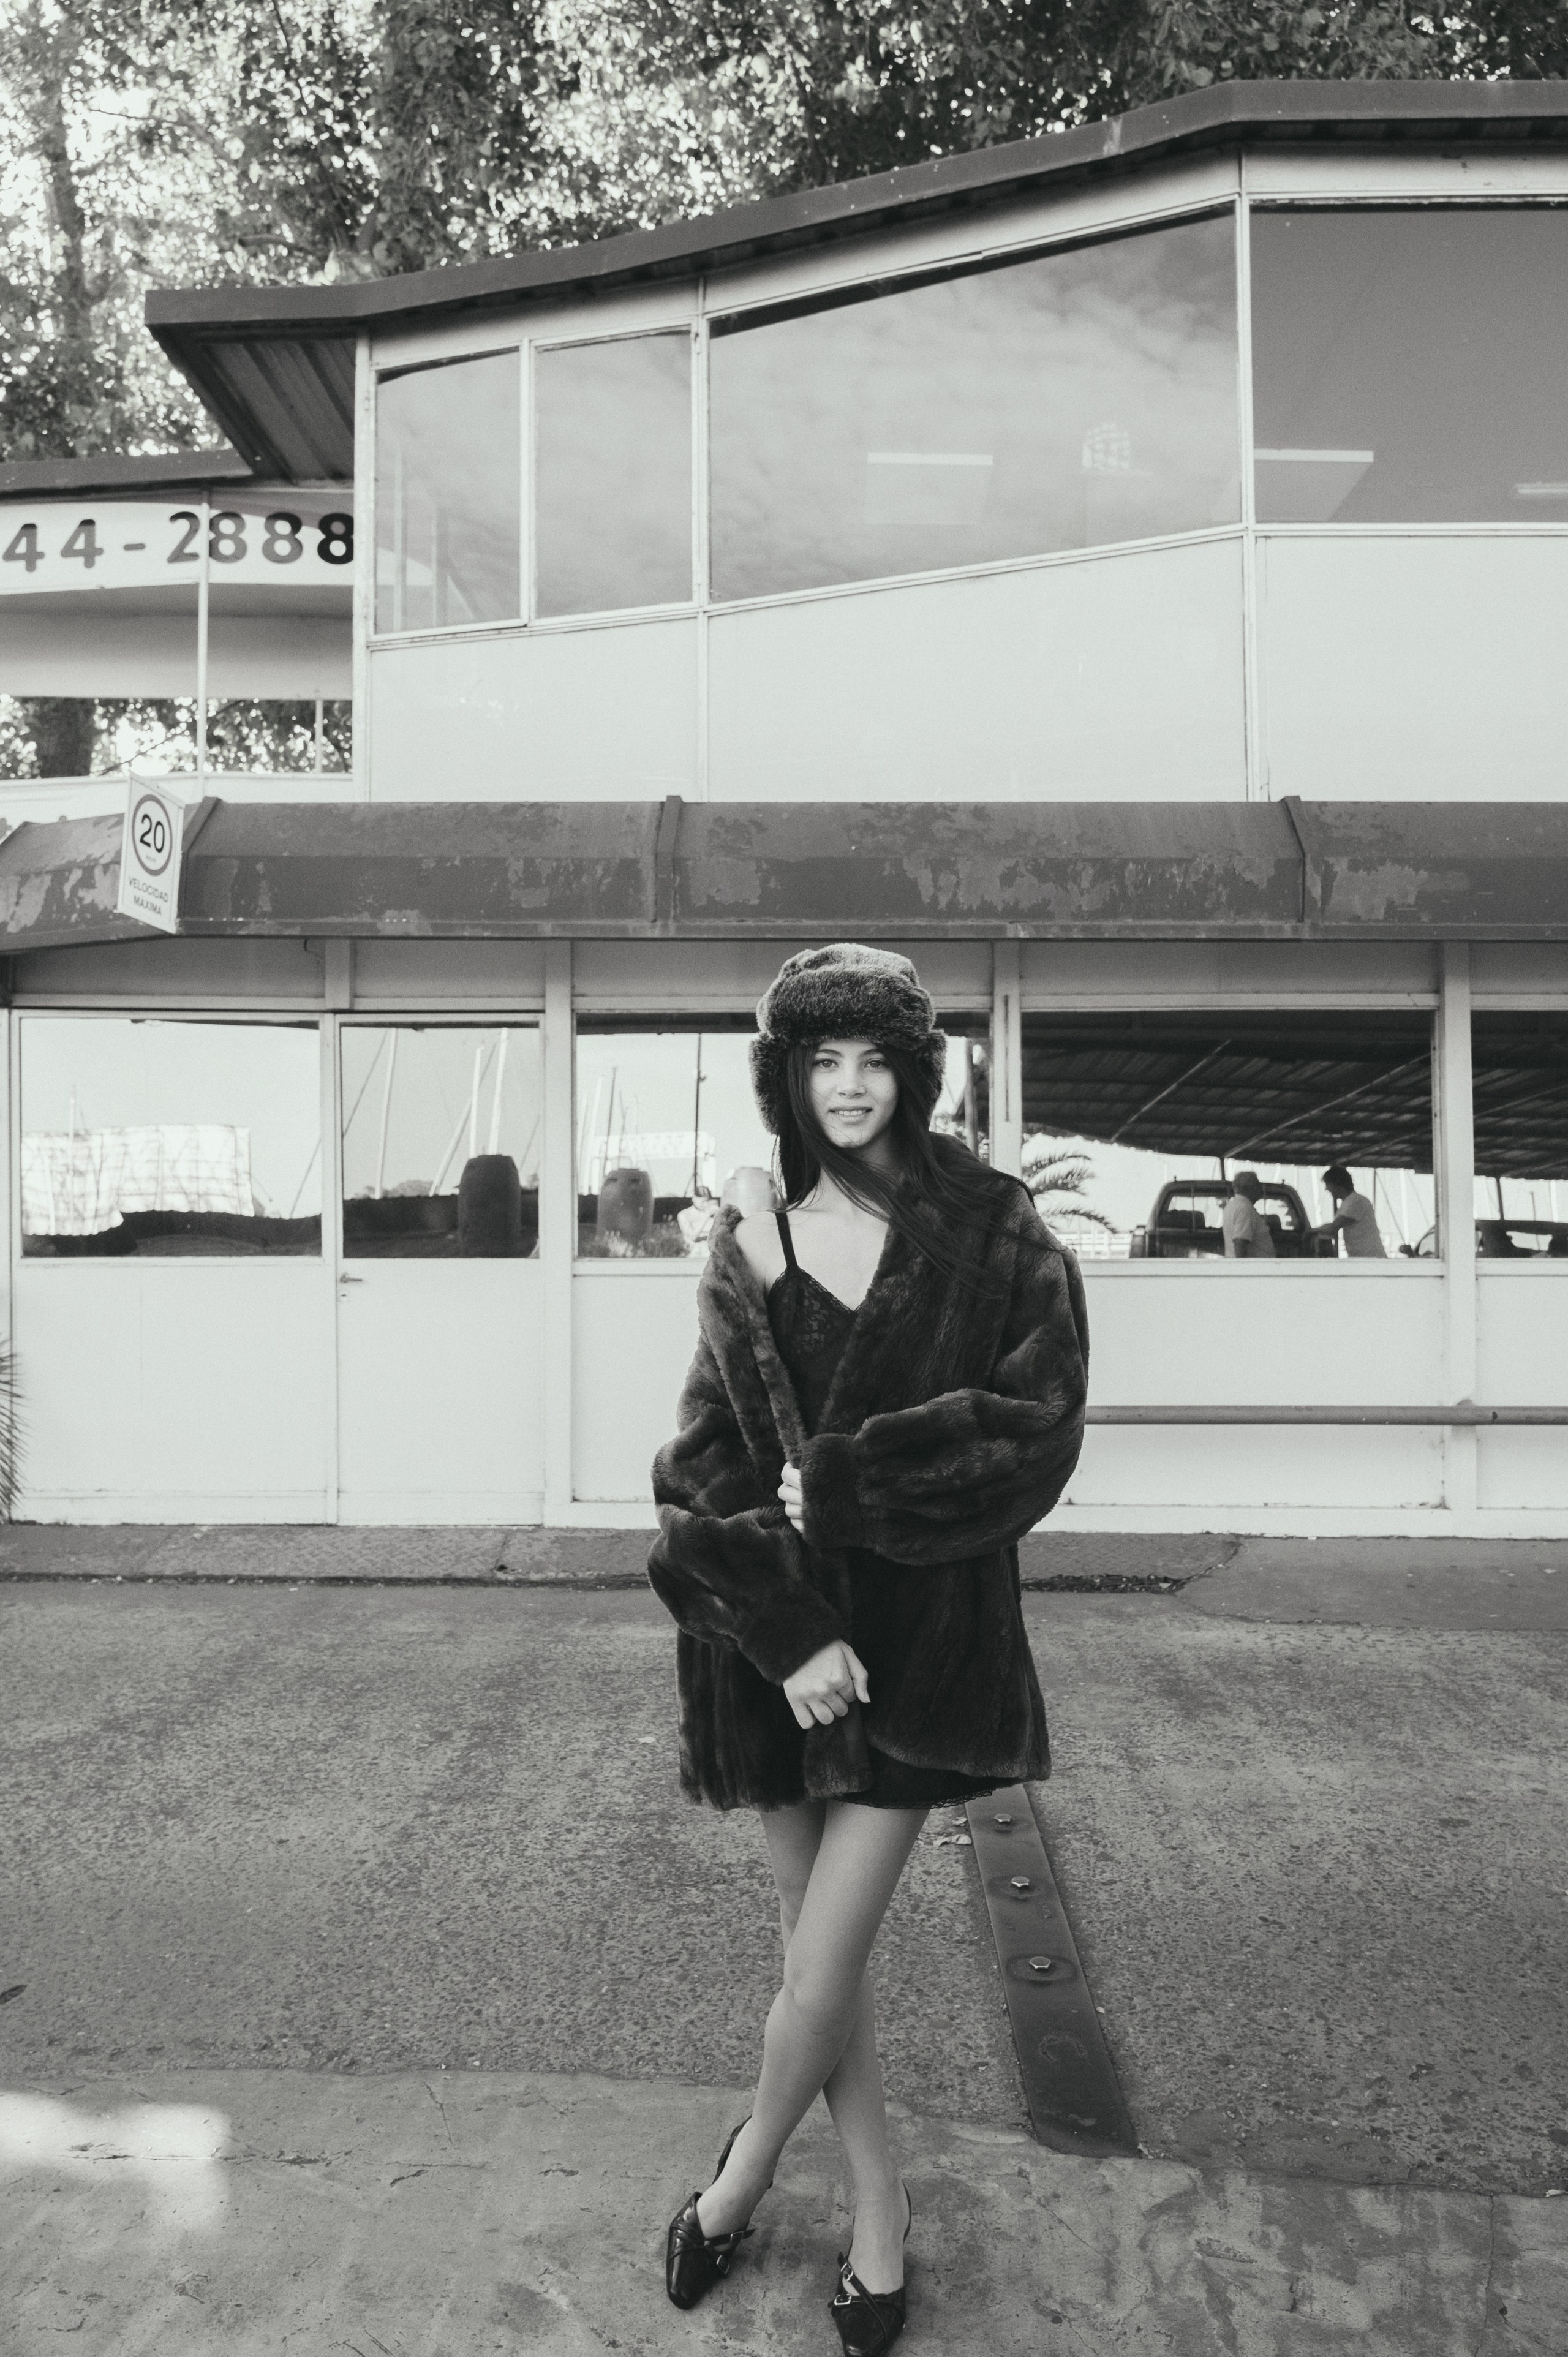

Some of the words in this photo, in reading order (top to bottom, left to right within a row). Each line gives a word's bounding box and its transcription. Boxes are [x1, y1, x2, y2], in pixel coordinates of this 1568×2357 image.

[2, 511, 354, 572] 44-2888
[140, 814, 165, 853] 20
[129, 877, 168, 903] VELOCIDAD
